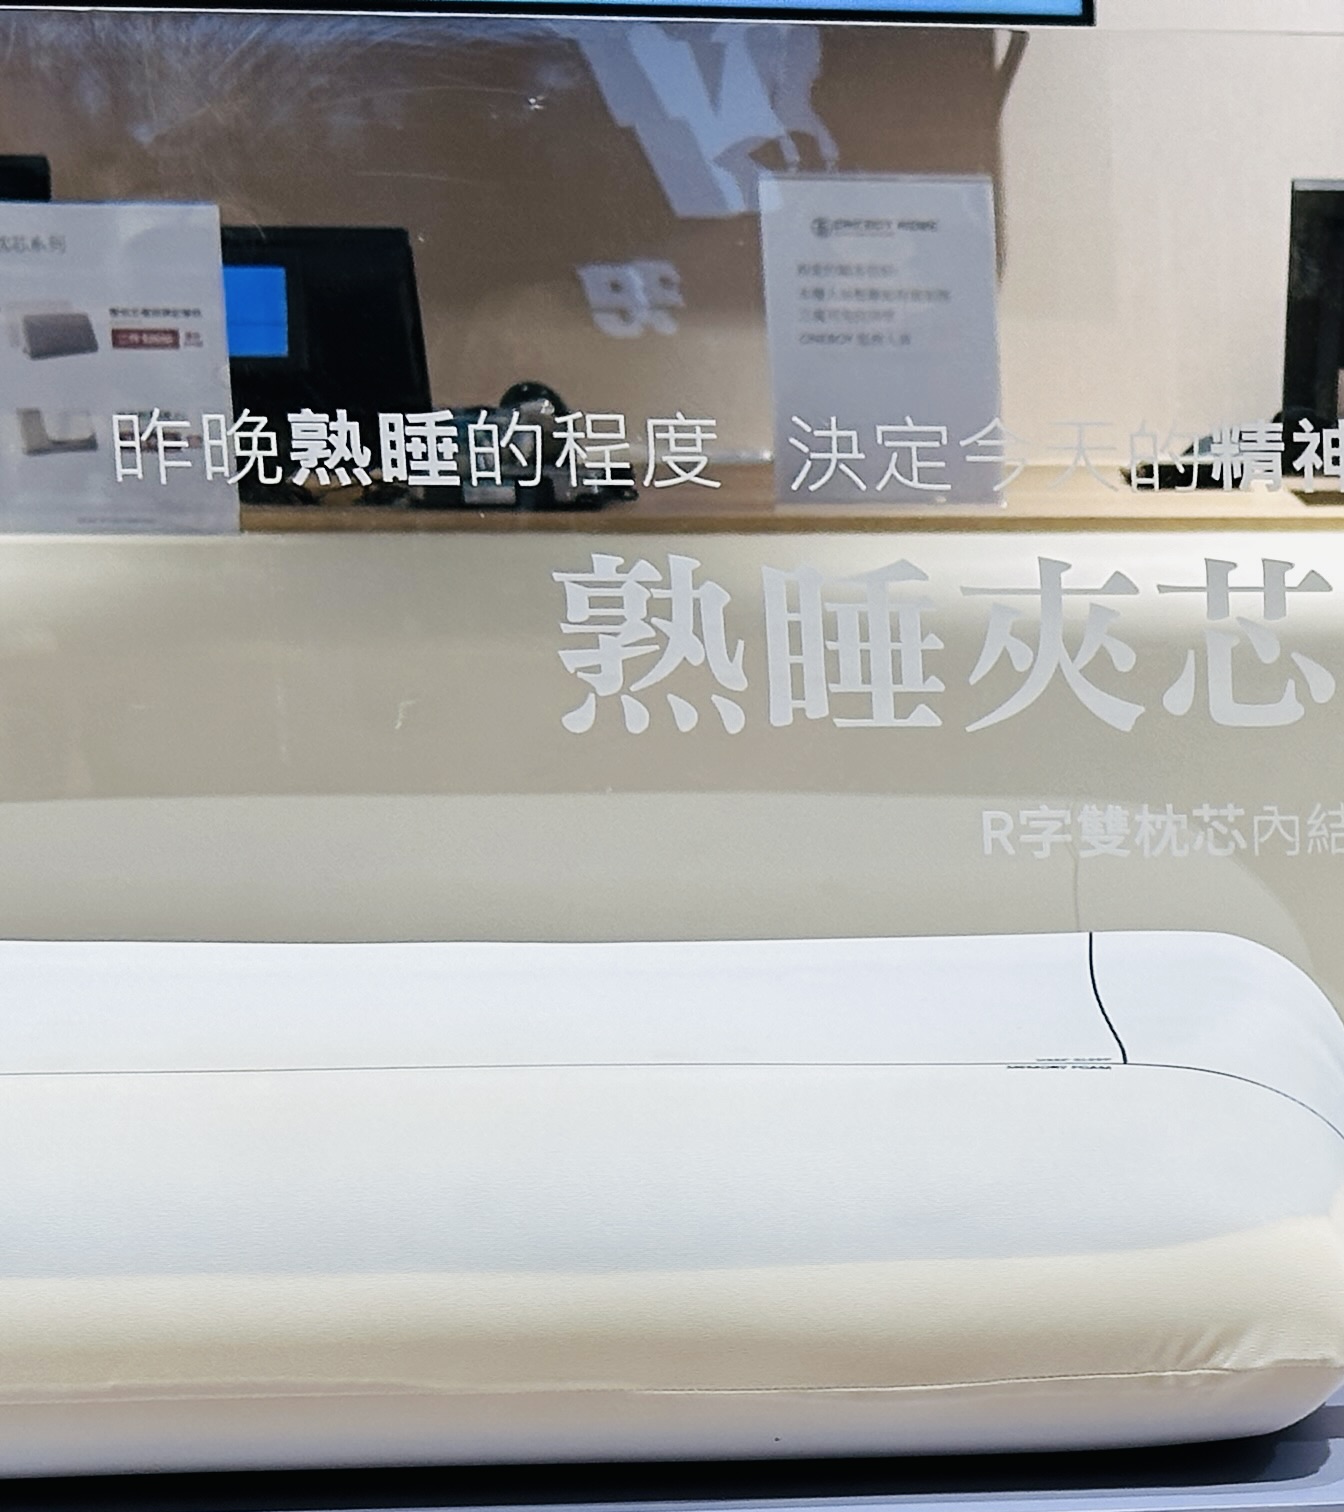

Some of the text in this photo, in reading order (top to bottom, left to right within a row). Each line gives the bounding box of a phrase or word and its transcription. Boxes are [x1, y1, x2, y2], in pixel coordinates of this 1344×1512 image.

[111, 407, 722, 488] 昨晚熟睡的程度
